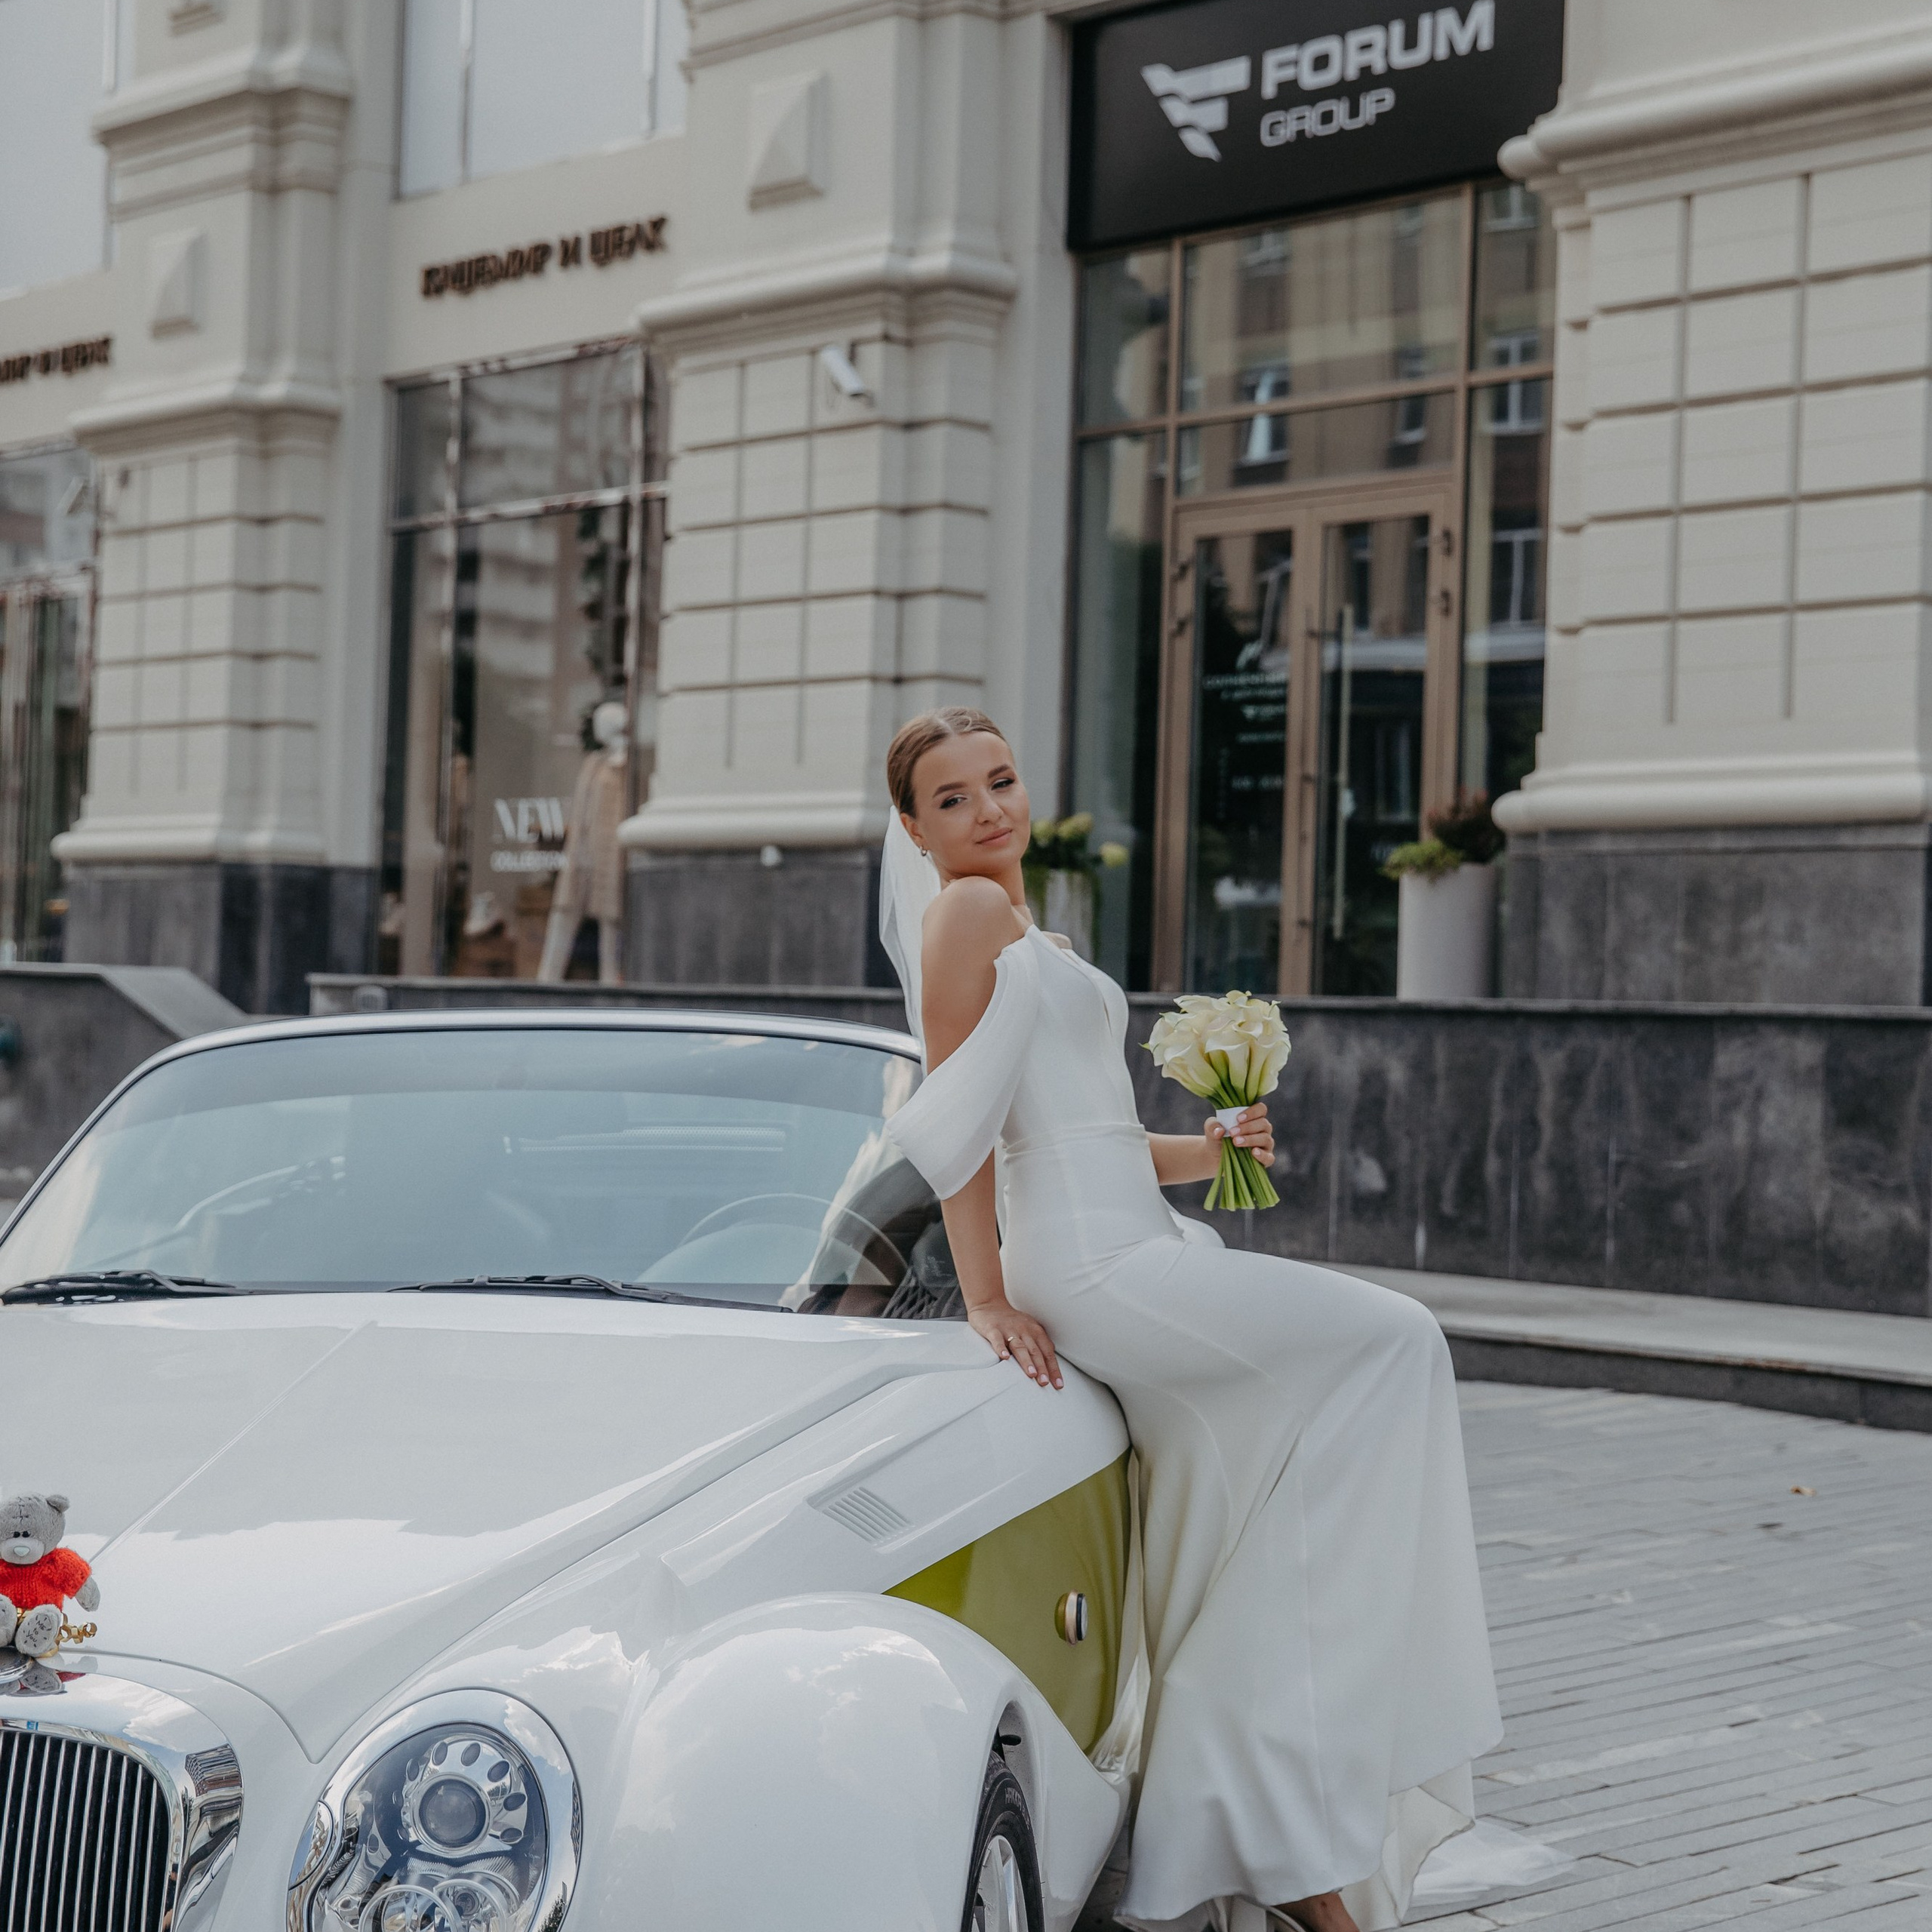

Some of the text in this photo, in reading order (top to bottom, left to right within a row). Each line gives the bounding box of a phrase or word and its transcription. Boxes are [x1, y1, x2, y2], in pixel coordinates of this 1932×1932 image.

[1260, 0, 1496, 100] FORUM
[1260, 87, 1395, 147] GROUP
[493, 798, 565, 843] NEW
[33, 1627, 38, 1635] to
